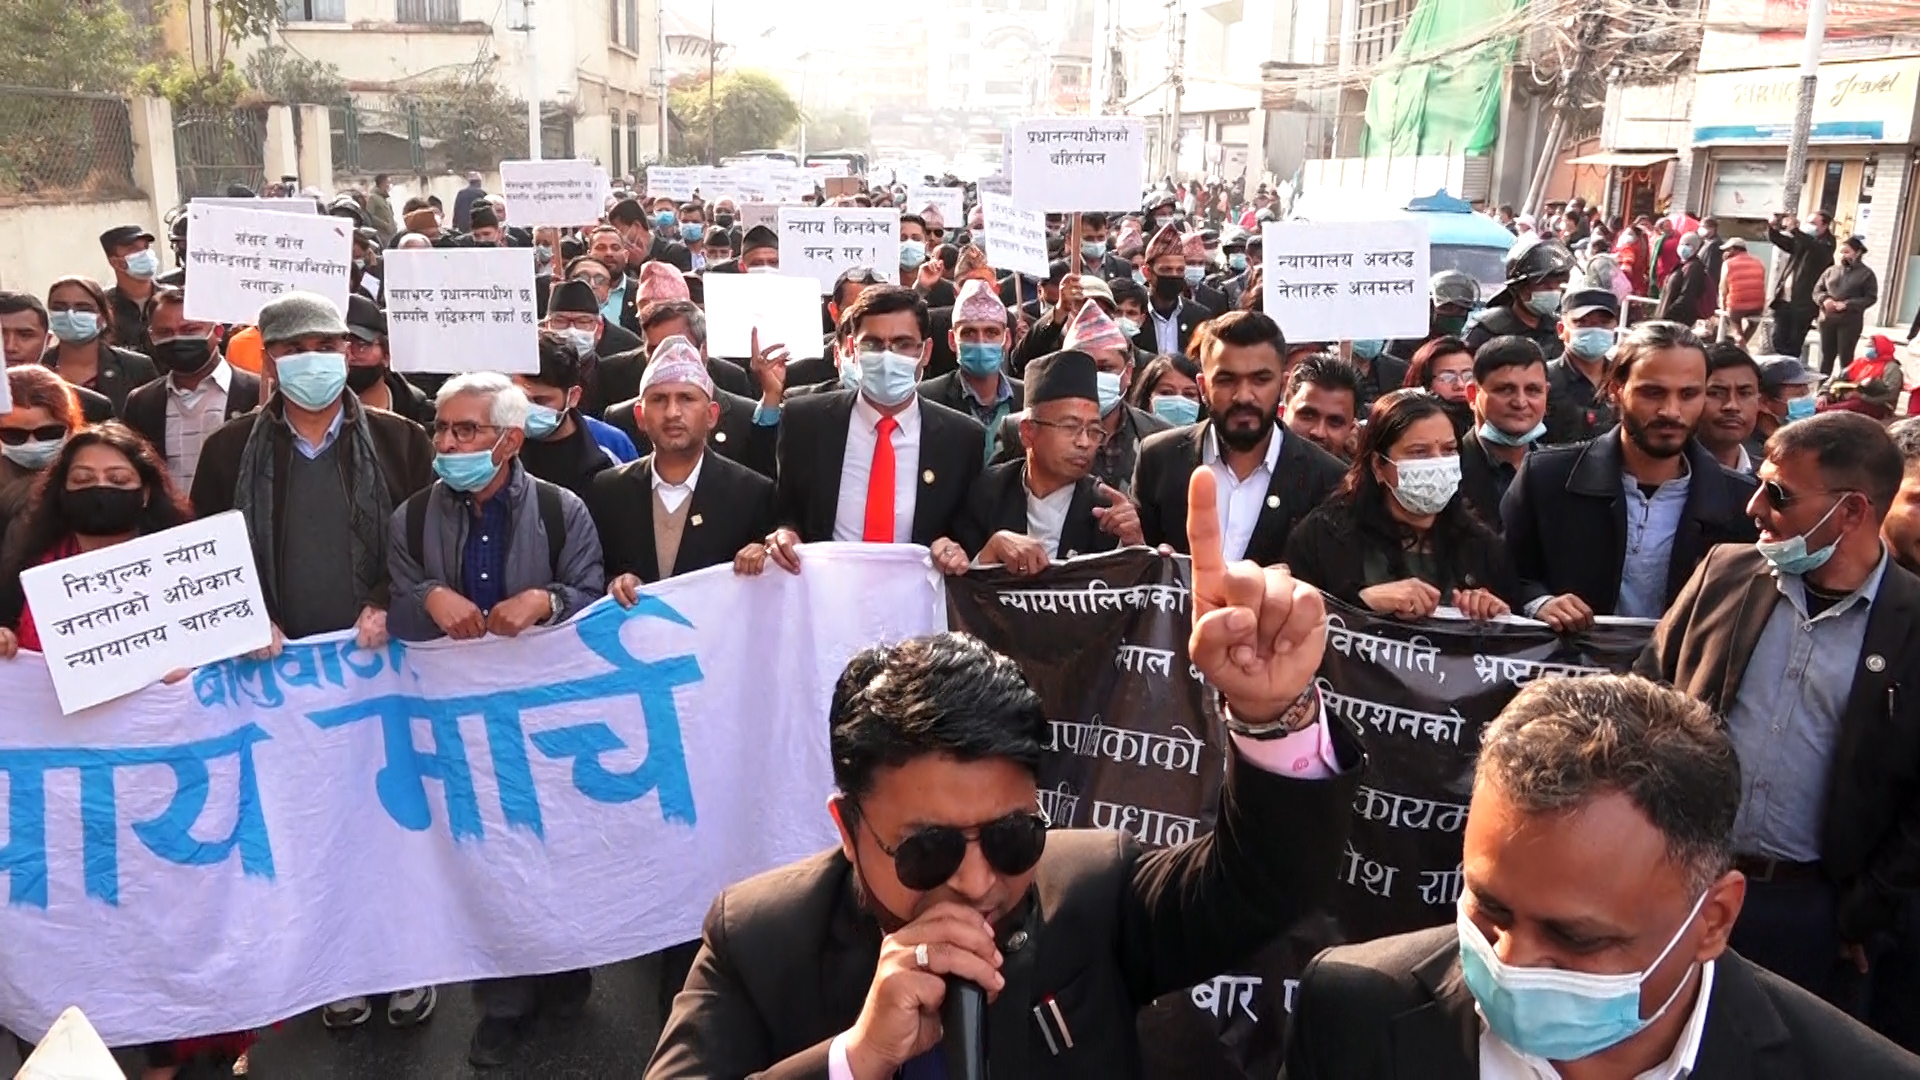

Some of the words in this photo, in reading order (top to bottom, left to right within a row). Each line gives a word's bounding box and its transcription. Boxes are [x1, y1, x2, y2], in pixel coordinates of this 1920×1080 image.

[787, 219, 826, 234] न्याय
[1278, 253, 1353, 268] न्यायालय
[1348, 279, 1415, 296] अलमस्त
[163, 539, 217, 565] न्याय
[52, 590, 150, 636] जनताको
[163, 565, 246, 604] अधिकार
[997, 578, 1190, 614] न्यायपालिकाको
[64, 624, 168, 669] न्यायालय
[303, 593, 704, 842] मार्च
[1191, 974, 1263, 1024] बार
